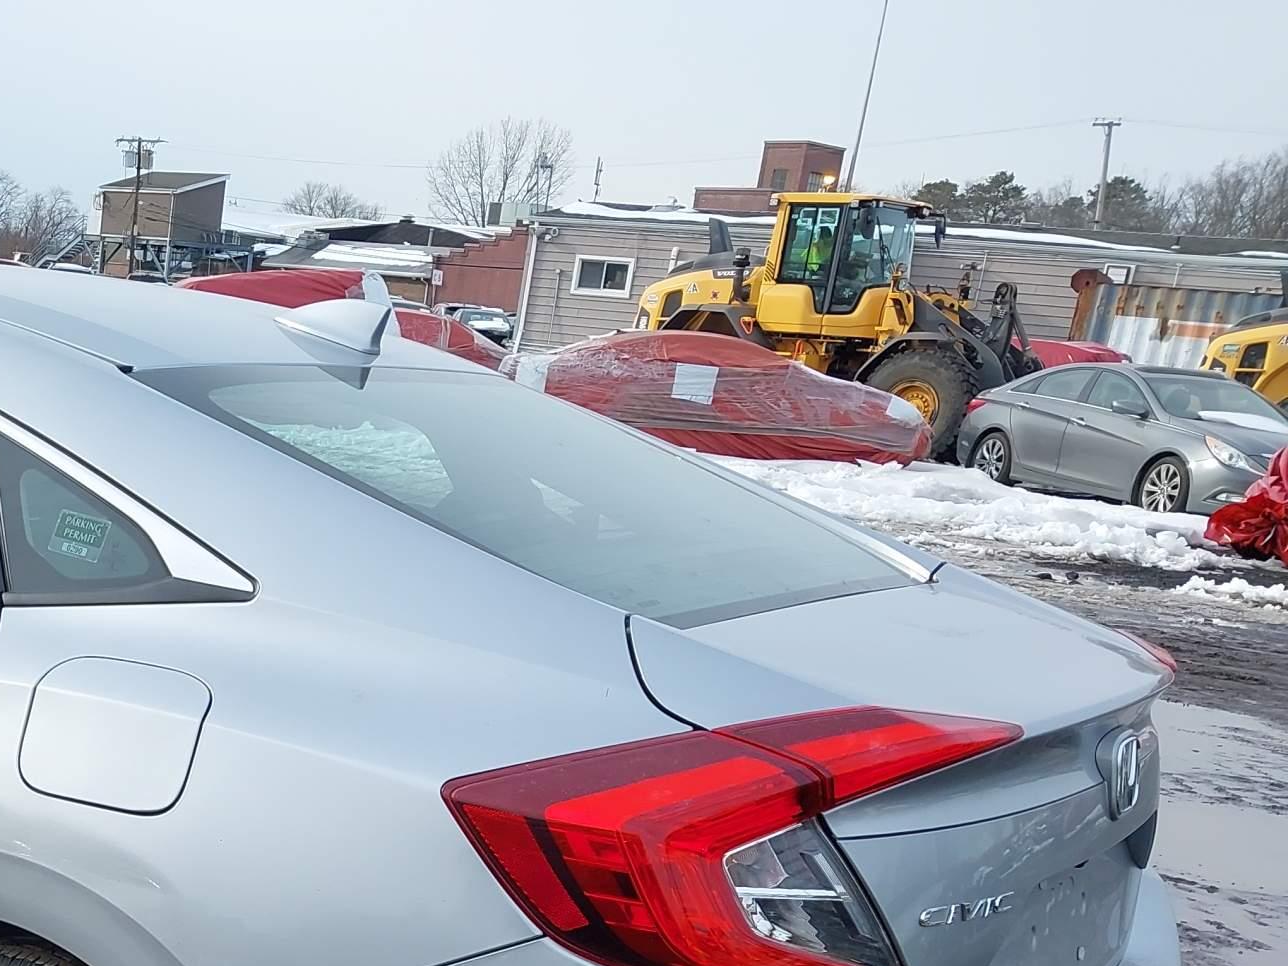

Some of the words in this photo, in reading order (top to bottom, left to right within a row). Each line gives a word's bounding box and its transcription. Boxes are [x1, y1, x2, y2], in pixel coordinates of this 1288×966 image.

[63, 528, 97, 544] PERMIT
[65, 515, 104, 537] PARKING
[919, 891, 1015, 927] CIVIC
